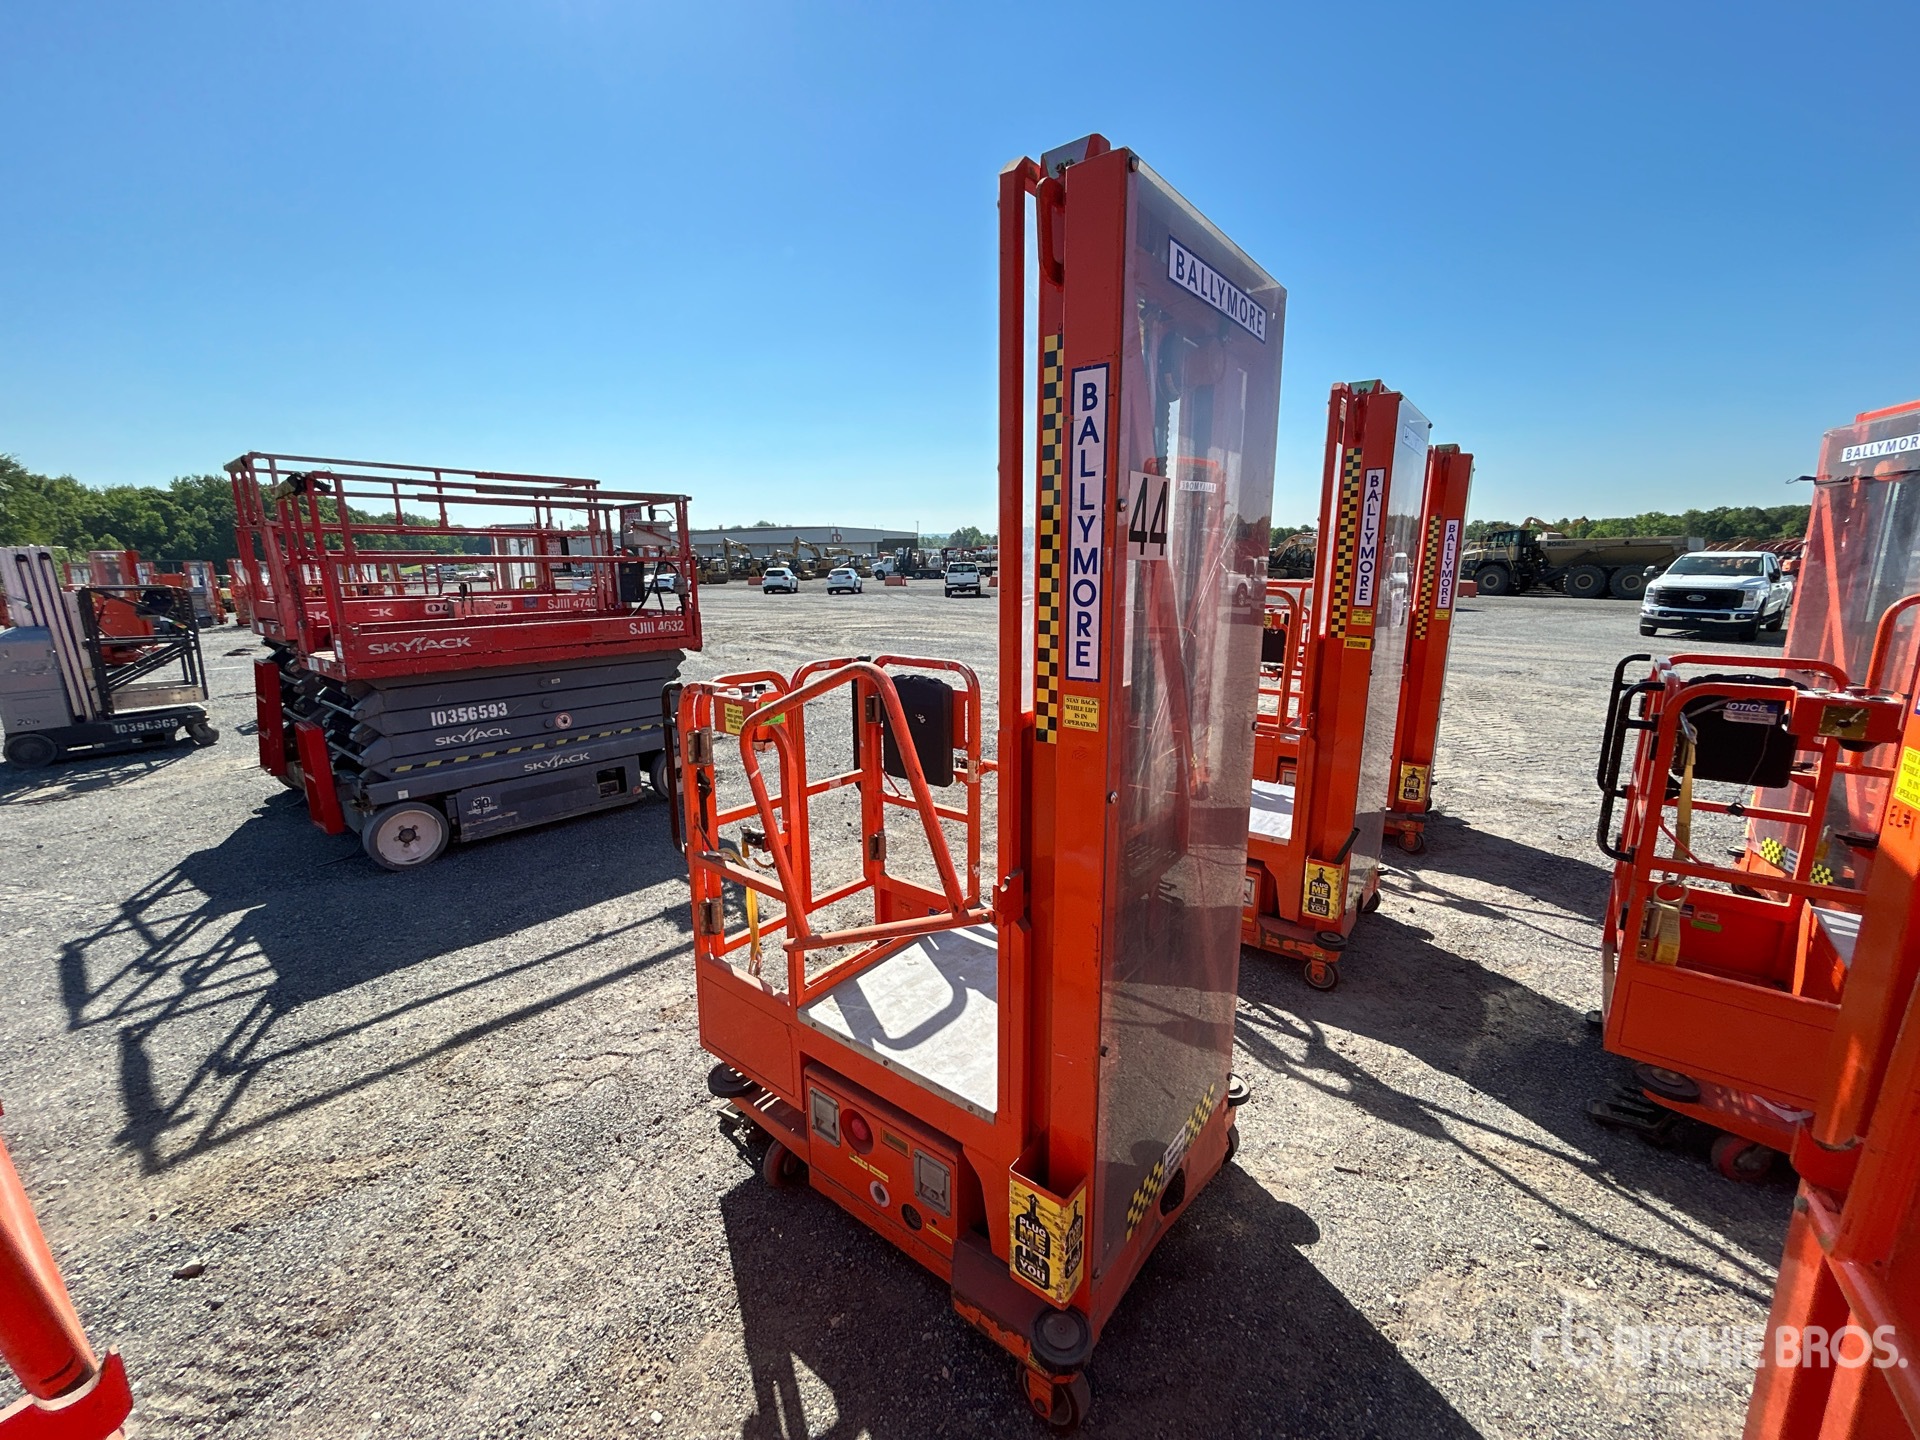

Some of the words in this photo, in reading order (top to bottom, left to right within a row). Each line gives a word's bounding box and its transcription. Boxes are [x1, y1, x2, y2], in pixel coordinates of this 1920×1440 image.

[1176, 249, 1263, 336] BALLYMORE
[1845, 436, 1919, 460] BALLYMOR
[1073, 382, 1100, 667] BALLYMORE
[1128, 477, 1168, 556] 44
[1359, 475, 1379, 600] BALLYMORE
[1440, 524, 1456, 605] BALLYMORE
[573, 597, 596, 608] 4740
[657, 620, 685, 632] 4632
[367, 636, 472, 655] SKYJACK
[430, 702, 508, 727] 10356593
[1065, 704, 1083, 712] WHILE
[1064, 719, 1097, 728] OPERATION
[435, 727, 511, 746] SKYJACK
[524, 752, 590, 772] SKYJACK
[1312, 881, 1328, 889] PLUG
[1312, 885, 1328, 895] ME
[1311, 904, 1327, 912] YOU
[1020, 1216, 1047, 1238] PLUG
[1020, 1224, 1046, 1250] ME
[1020, 1258, 1045, 1282] YOU
